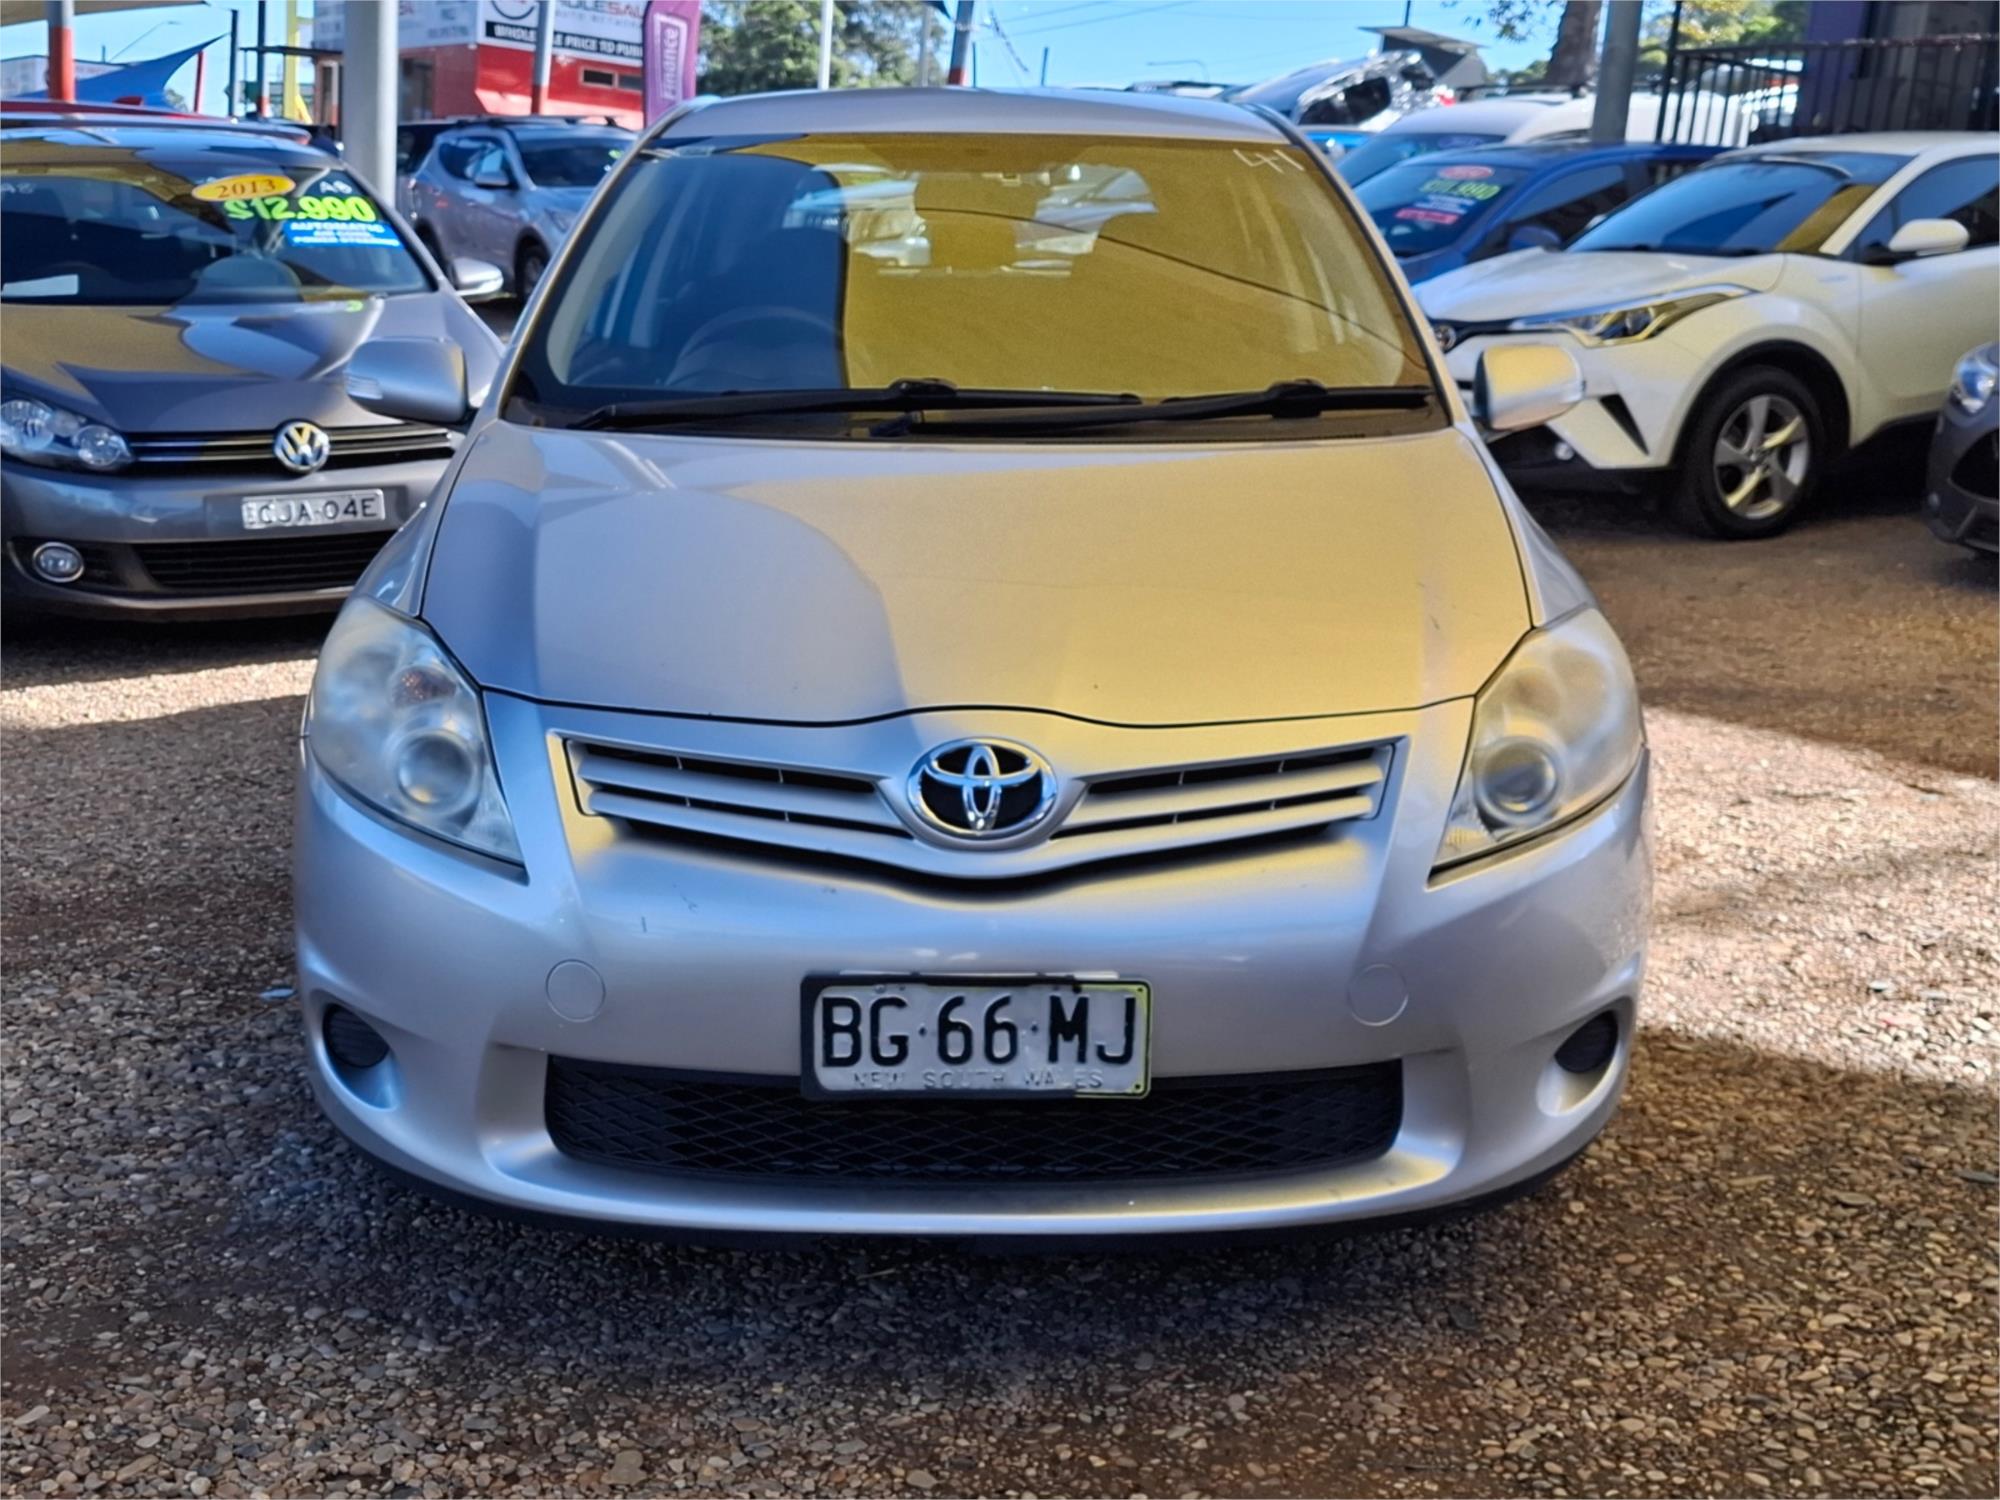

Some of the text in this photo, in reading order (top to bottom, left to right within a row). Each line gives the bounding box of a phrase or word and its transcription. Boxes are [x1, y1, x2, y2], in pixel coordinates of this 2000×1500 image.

[564, 34, 598, 52] PRICE
[599, 40, 616, 55] TO
[663, 27, 680, 100] Finance
[216, 178, 277, 200] 2013
[853, 1069, 1104, 1089] NEW SOUTH WALES
